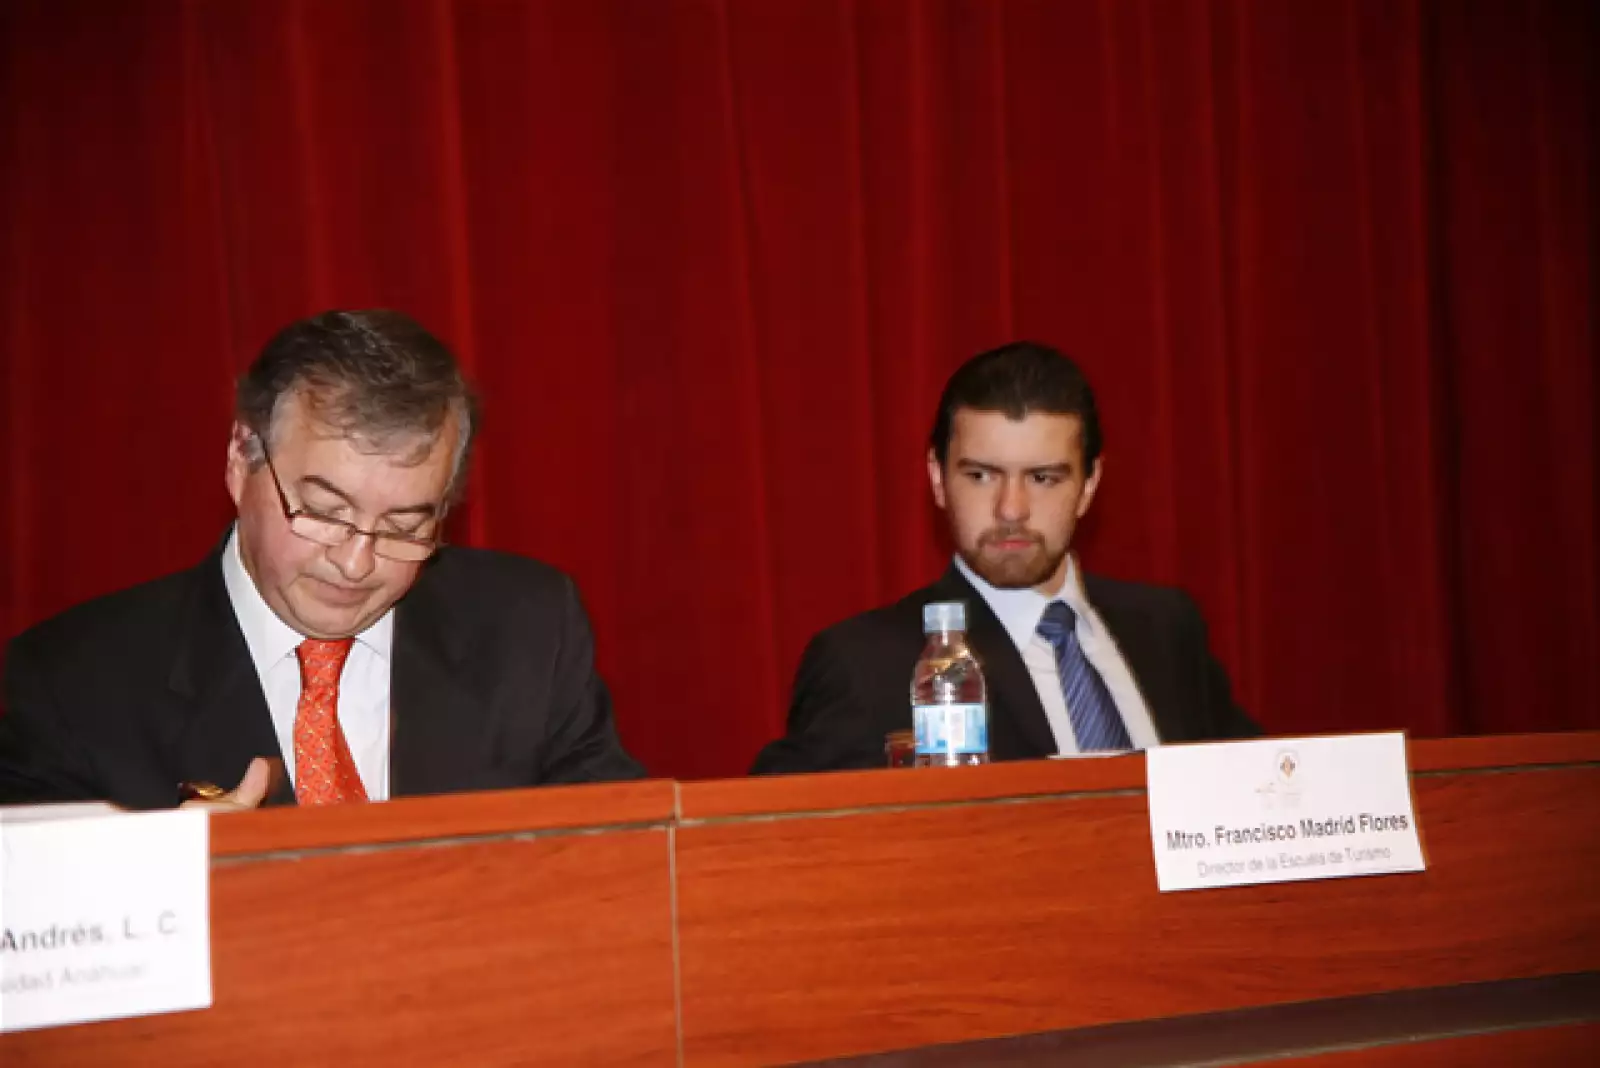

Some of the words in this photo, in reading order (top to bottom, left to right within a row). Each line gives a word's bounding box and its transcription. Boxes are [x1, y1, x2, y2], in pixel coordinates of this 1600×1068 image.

[1167, 830, 1211, 851] Mtro.
[1215, 824, 1296, 846] Francisco
[1300, 816, 1355, 837] Madrid
[1359, 813, 1409, 833] Flores
[1197, 860, 1245, 877] Director
[1248, 857, 1263, 871] de
[1266, 855, 1278, 869] la
[1279, 852, 1326, 869] Escuela
[1328, 851, 1343, 864] de
[1344, 847, 1392, 862] Turismo
